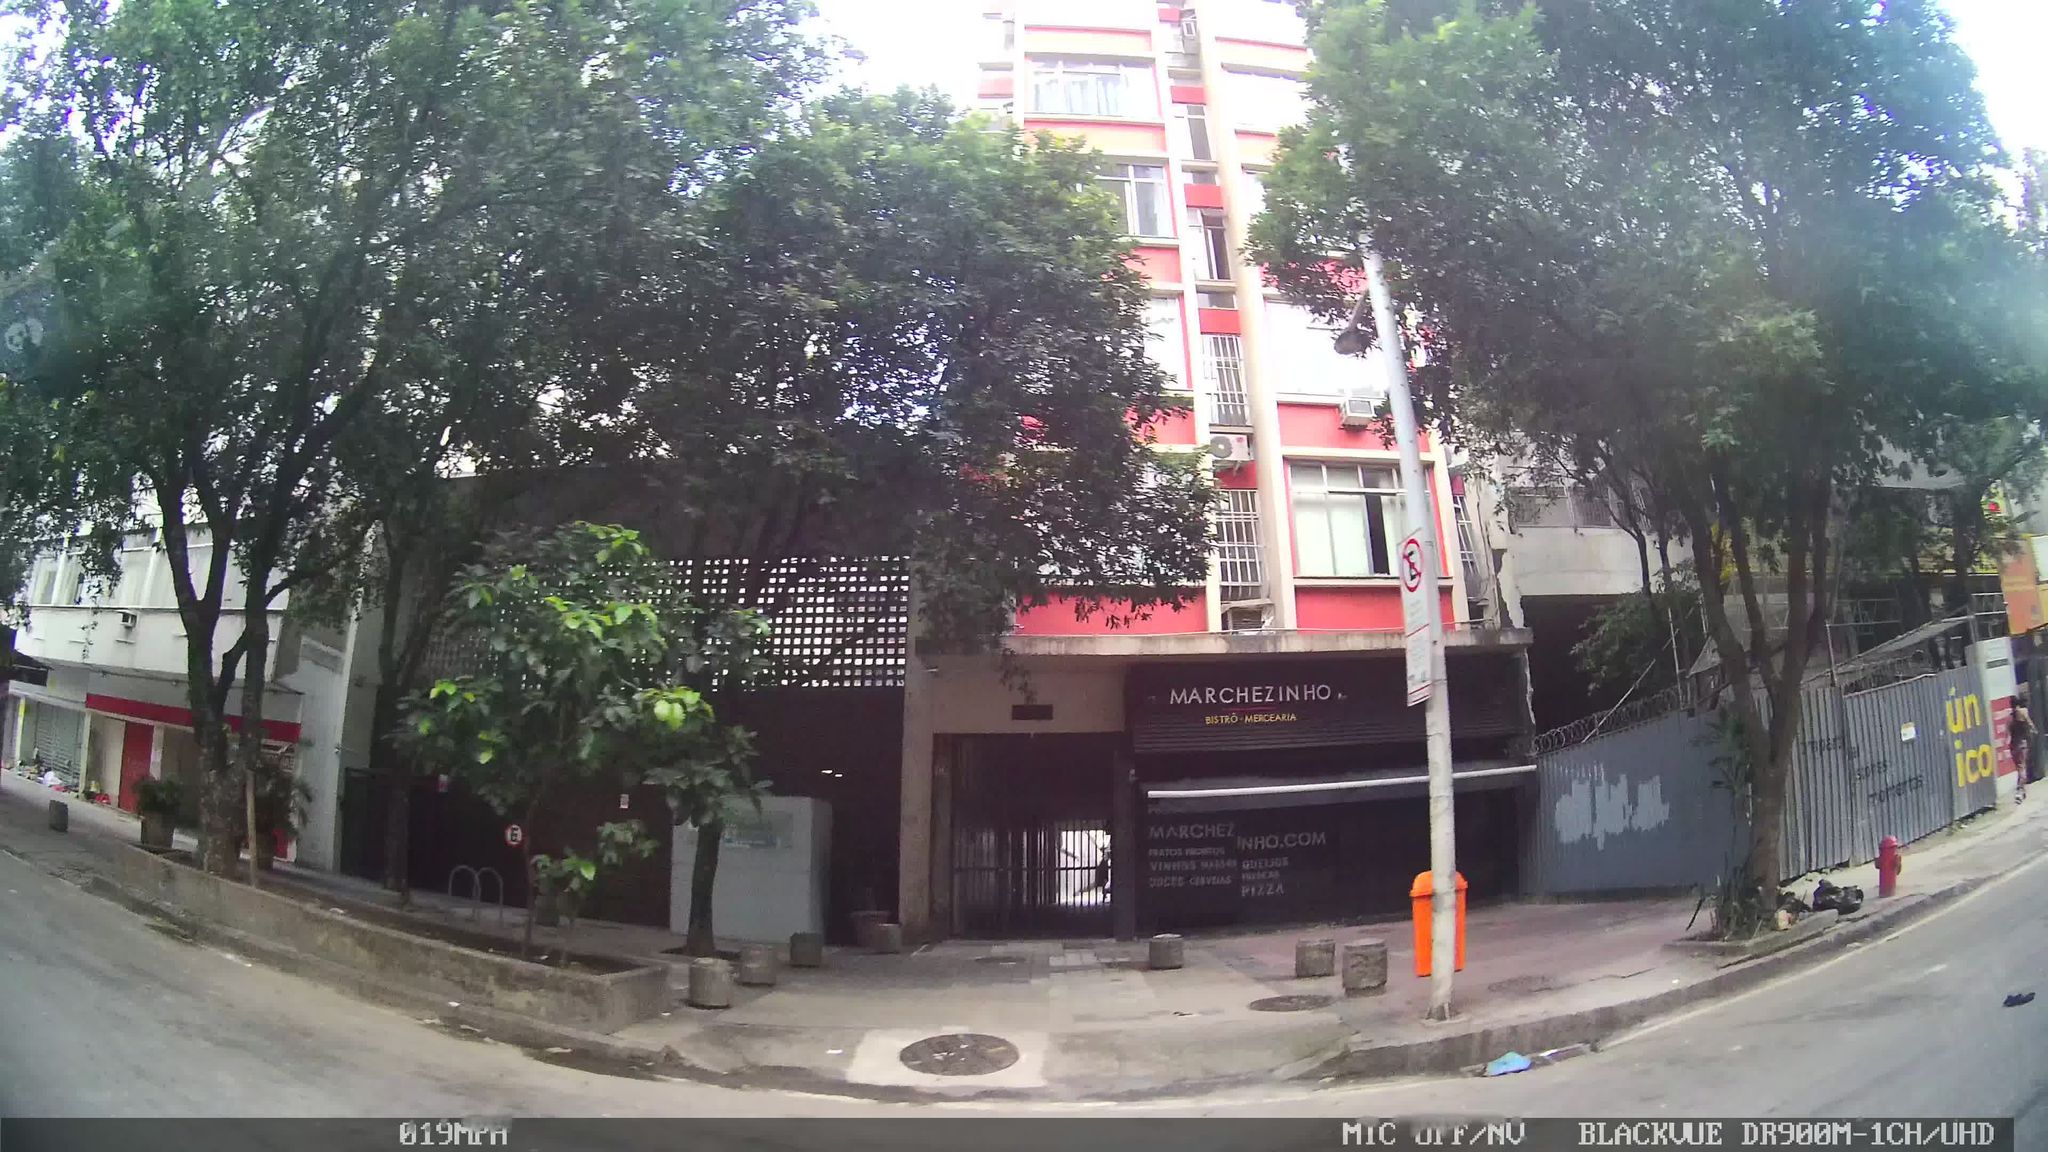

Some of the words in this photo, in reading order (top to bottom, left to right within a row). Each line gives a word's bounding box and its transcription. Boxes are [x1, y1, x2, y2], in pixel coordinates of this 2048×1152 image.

[1169, 684, 1331, 704] MARCHEZINHO
[1205, 712, 1239, 725] BISTRÔ
[1244, 713, 1297, 724] MERCEARIA
[1955, 739, 1993, 788] ico
[1241, 882, 1285, 897] PIZZA
